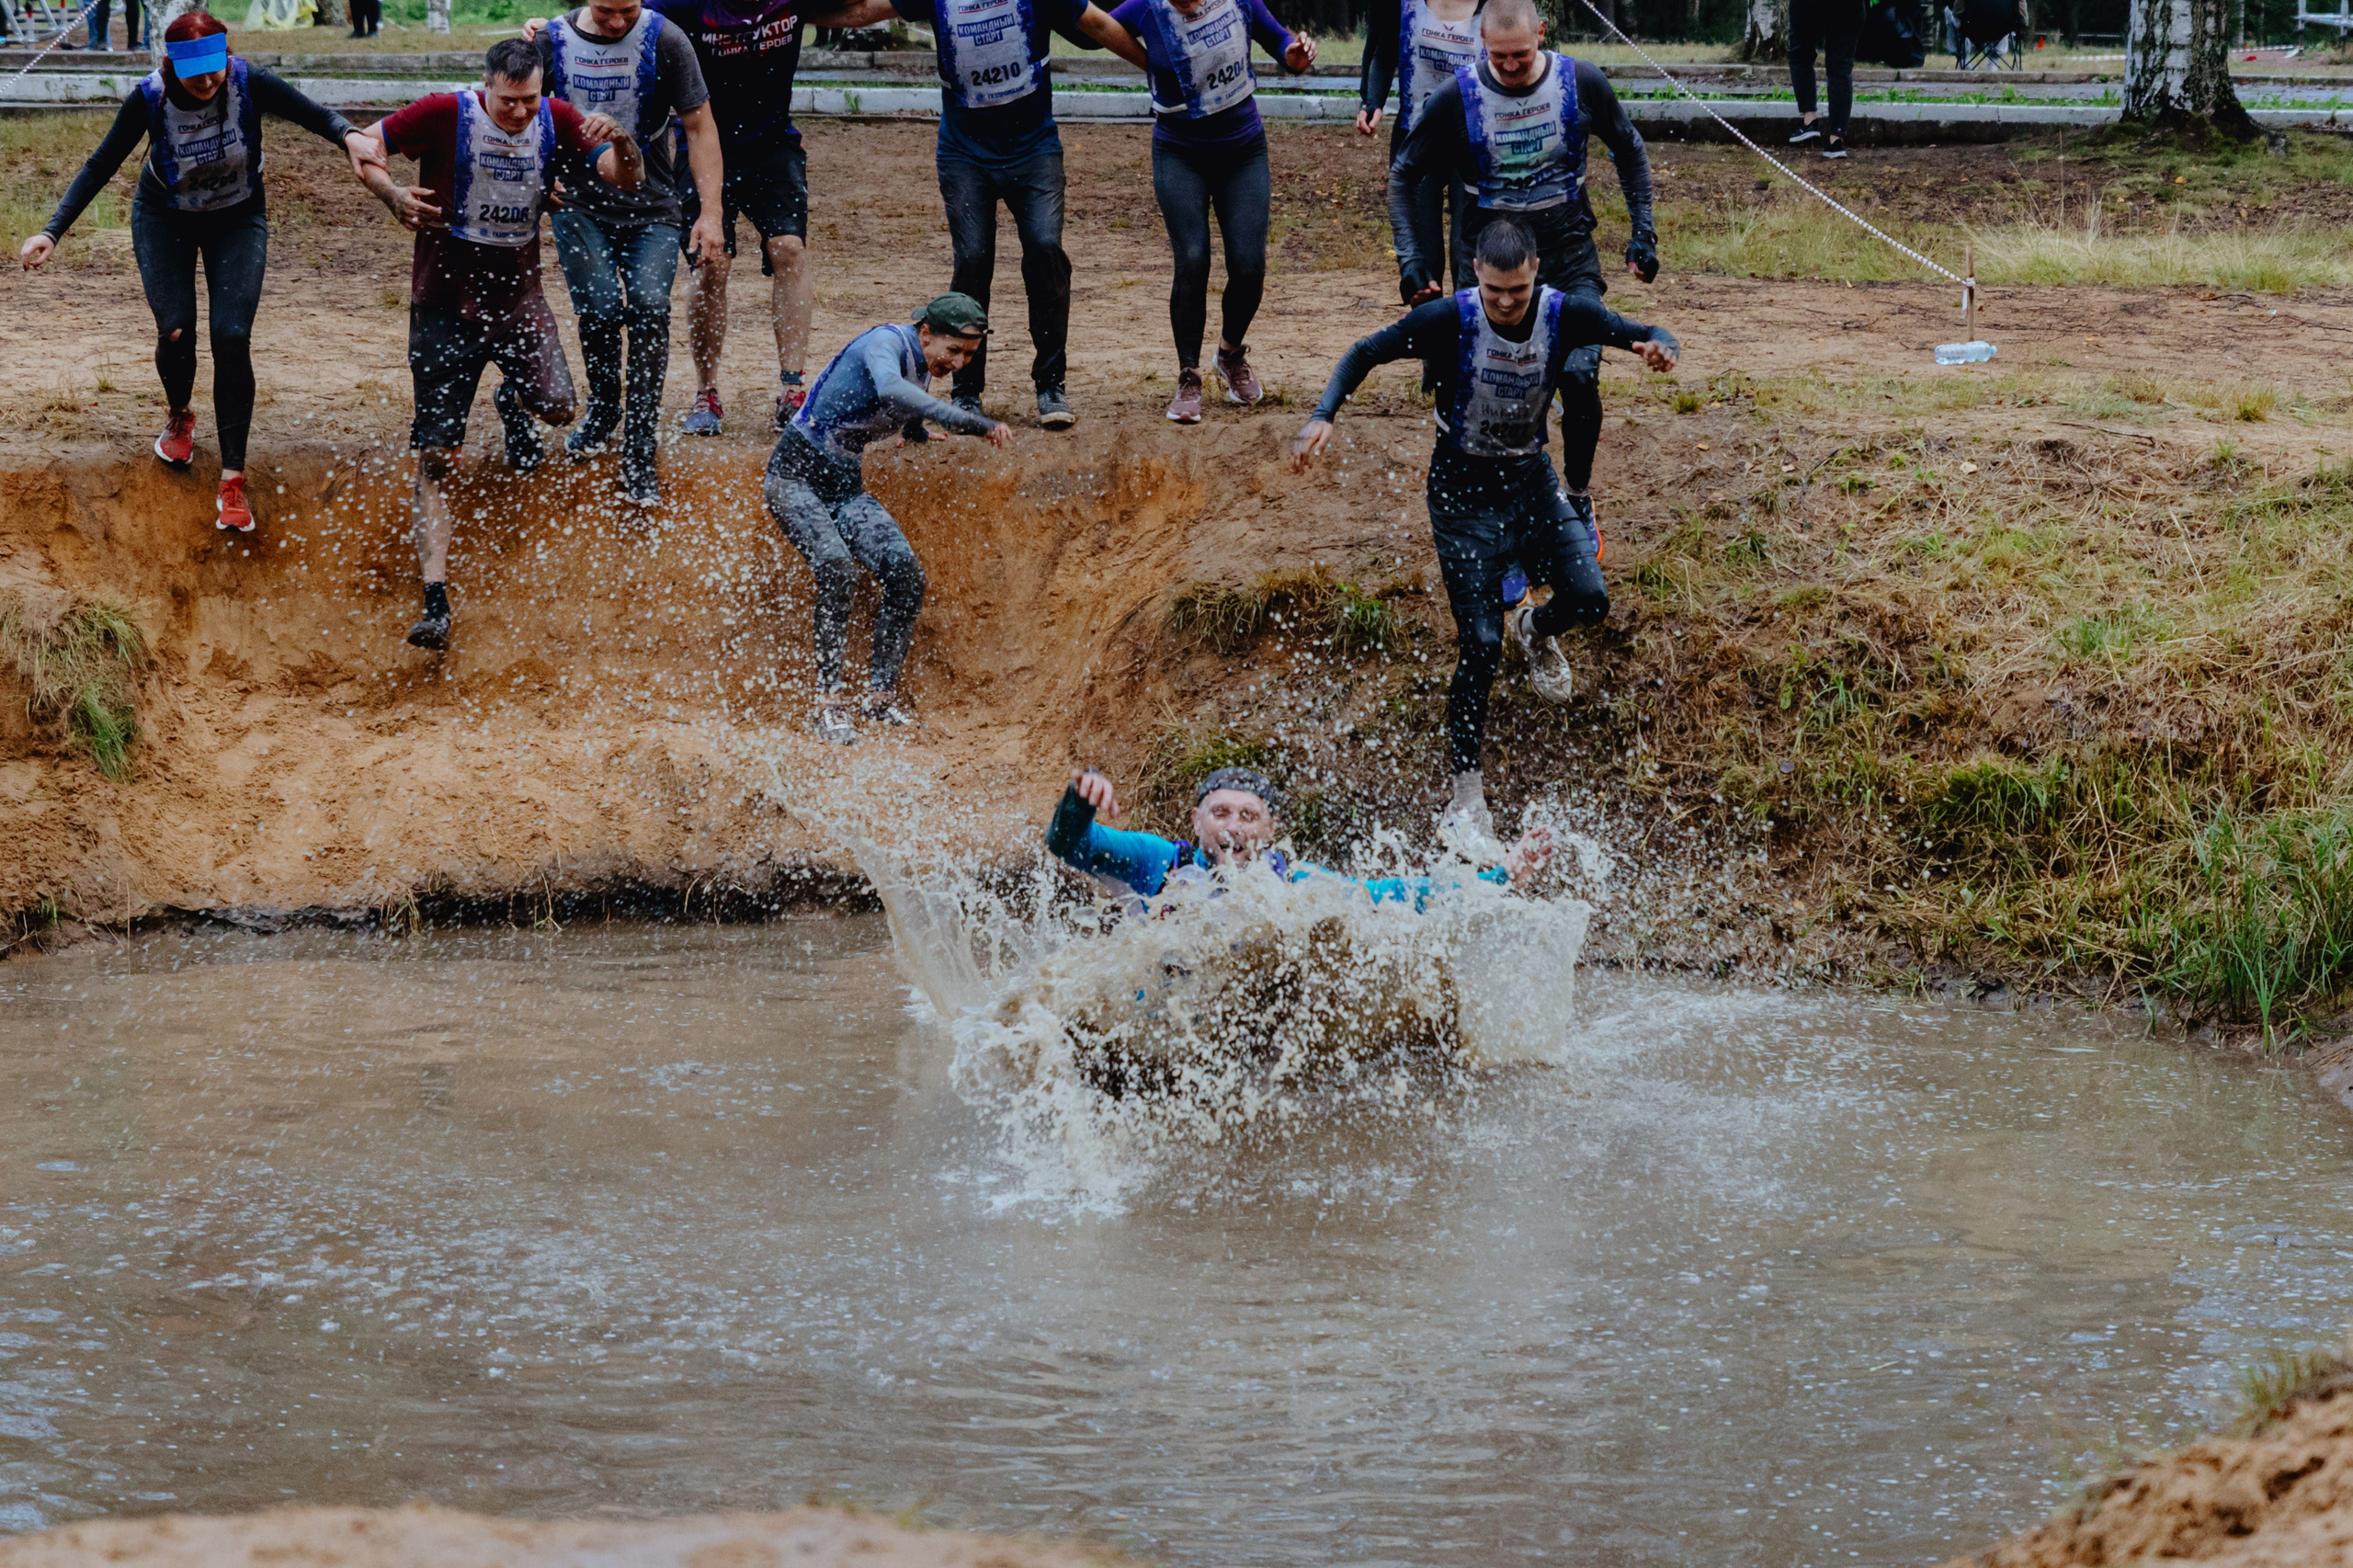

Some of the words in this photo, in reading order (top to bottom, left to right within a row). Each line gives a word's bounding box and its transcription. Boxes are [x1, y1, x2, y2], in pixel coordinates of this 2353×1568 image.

[982, 0, 1008, 8] ГЕРО
[958, 14, 1014, 35] КОМАНДНЫЙ
[753, 33, 793, 51] ГЕРОЕВ
[975, 30, 1002, 45] СТАРТ
[1206, 28, 1230, 46] СТАРТ
[1422, 28, 1446, 39] ГОНКА
[1448, 33, 1474, 42] ГЕРОЕВ
[574, 56, 598, 64] ГОНКА
[971, 62, 1021, 86] 24210
[574, 75, 630, 90] КОМАНДНЫЙ
[1495, 110, 1521, 119] ГОНКА
[1522, 103, 1551, 115] ГЕРОЕВ
[483, 135, 507, 144] ГОНКА
[1495, 121, 1556, 143] КОМАНДНЫЙ
[1513, 141, 1541, 153] СТАРТ
[1486, 348, 1512, 358] ГОНКА
[1497, 386, 1523, 397] СТАРТ
